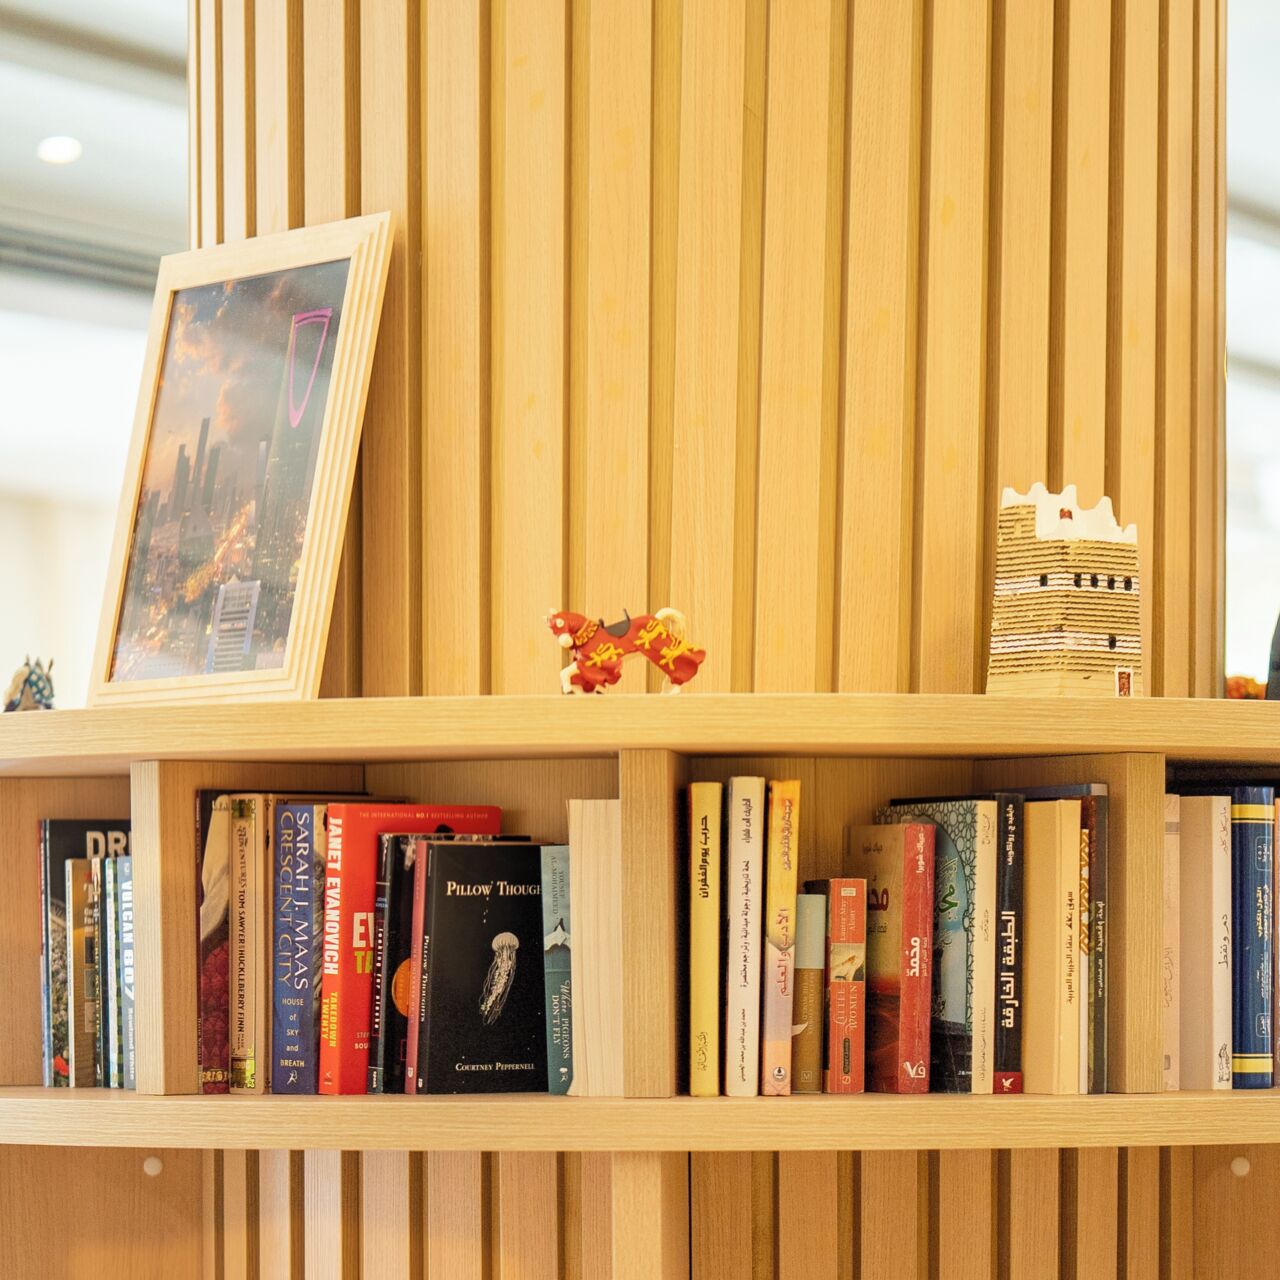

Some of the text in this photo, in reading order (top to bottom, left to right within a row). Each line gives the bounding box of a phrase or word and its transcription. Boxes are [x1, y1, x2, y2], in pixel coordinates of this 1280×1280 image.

[699, 815, 710, 845] حرب
[86, 831, 131, 859] DR
[278, 811, 294, 987] CRESCENT CITY
[293, 811, 310, 990] SARAH J. MAAS
[324, 817, 343, 975] JANET EVANOVICH
[446, 881, 493, 896] PILLOW
[122, 881, 133, 943] VULCAN
[1001, 911, 1019, 1028] الطبقة الخارقة
[282, 998, 304, 1006] HOUSE
[289, 1013, 297, 1021] of
[329, 991, 338, 1047] TAKEDOWN
[286, 1029, 299, 1037] SKY
[553, 1027, 561, 1045] FLY
[562, 1017, 570, 1059] PIGEONS
[280, 1059, 305, 1067] BREATH
[455, 1062, 535, 1071] COURTNEY PEPPERNELL
